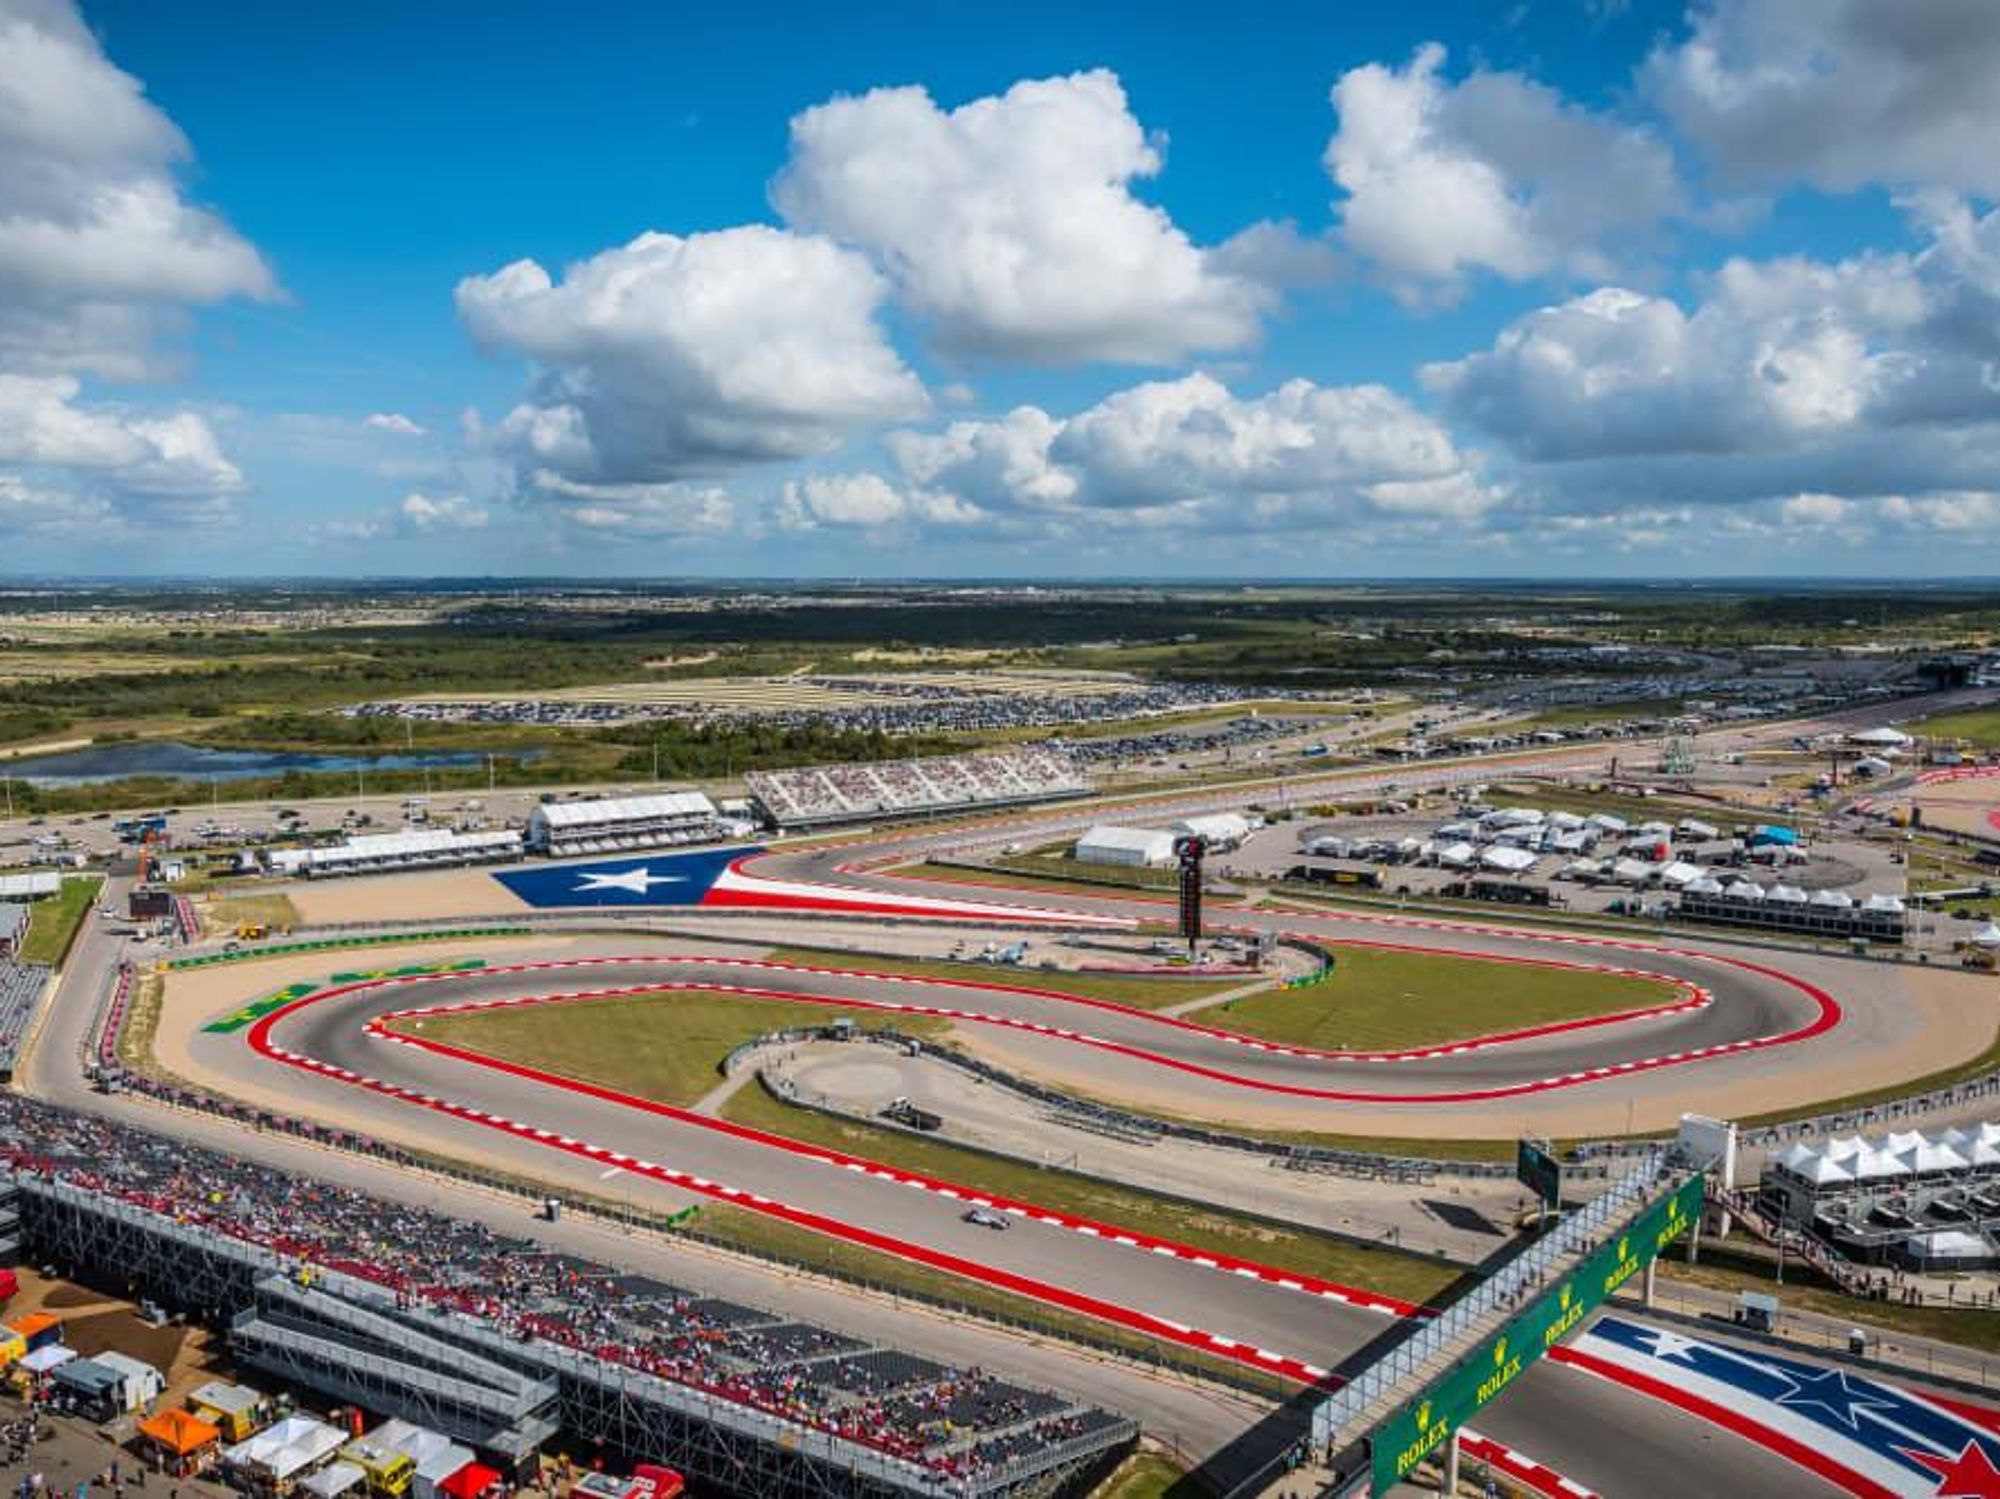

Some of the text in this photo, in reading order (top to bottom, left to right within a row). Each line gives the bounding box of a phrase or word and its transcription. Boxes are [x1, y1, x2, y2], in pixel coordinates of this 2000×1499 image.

[1545, 1298, 1584, 1346] ROLEX
[1477, 1352, 1522, 1405] ROLEX
[1397, 1416, 1449, 1476] ROLEX
